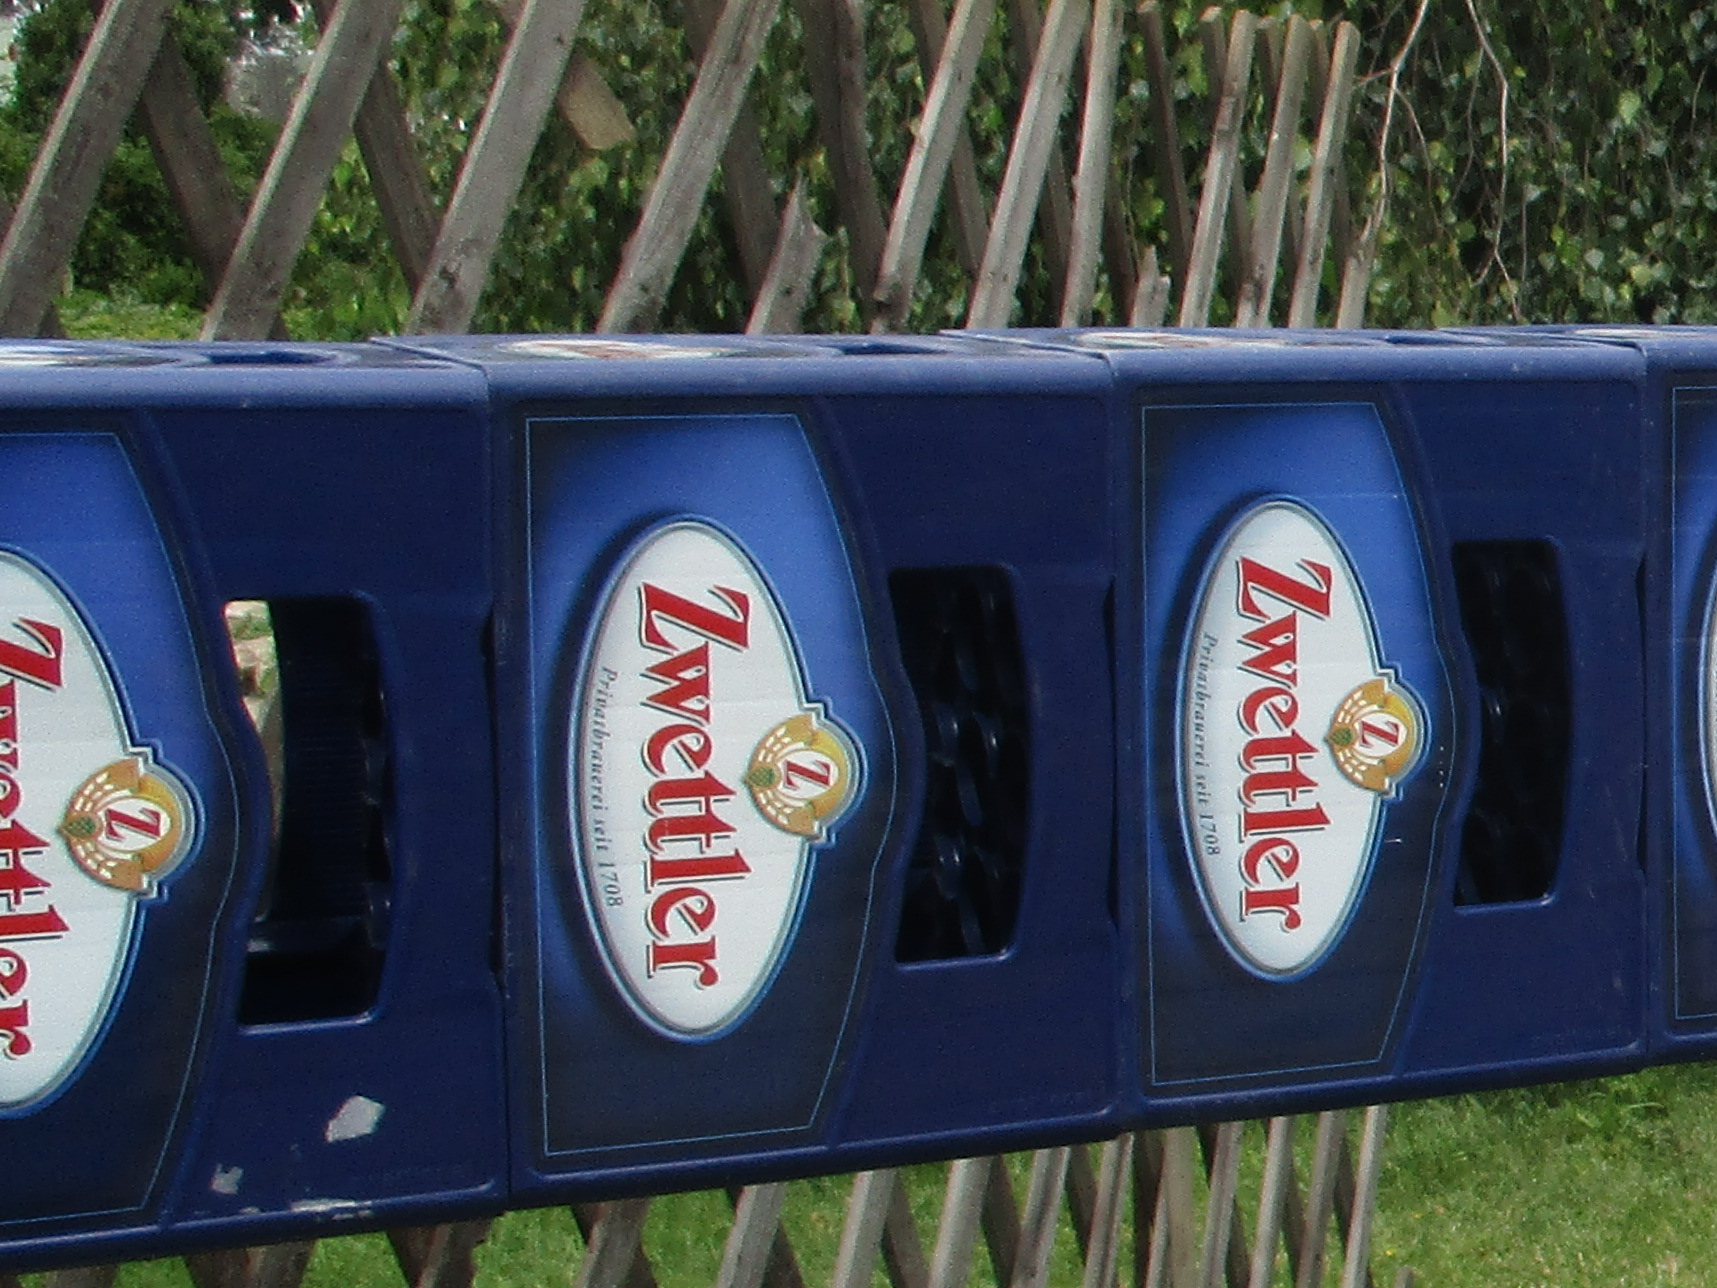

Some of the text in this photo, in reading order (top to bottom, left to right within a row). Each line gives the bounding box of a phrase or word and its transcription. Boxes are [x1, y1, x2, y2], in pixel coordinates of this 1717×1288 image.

[639, 581, 753, 991] Zwettler
[1200, 814, 1221, 857] 1708
[1236, 555, 1333, 933] Zwettler
[598, 863, 623, 907] 1708
